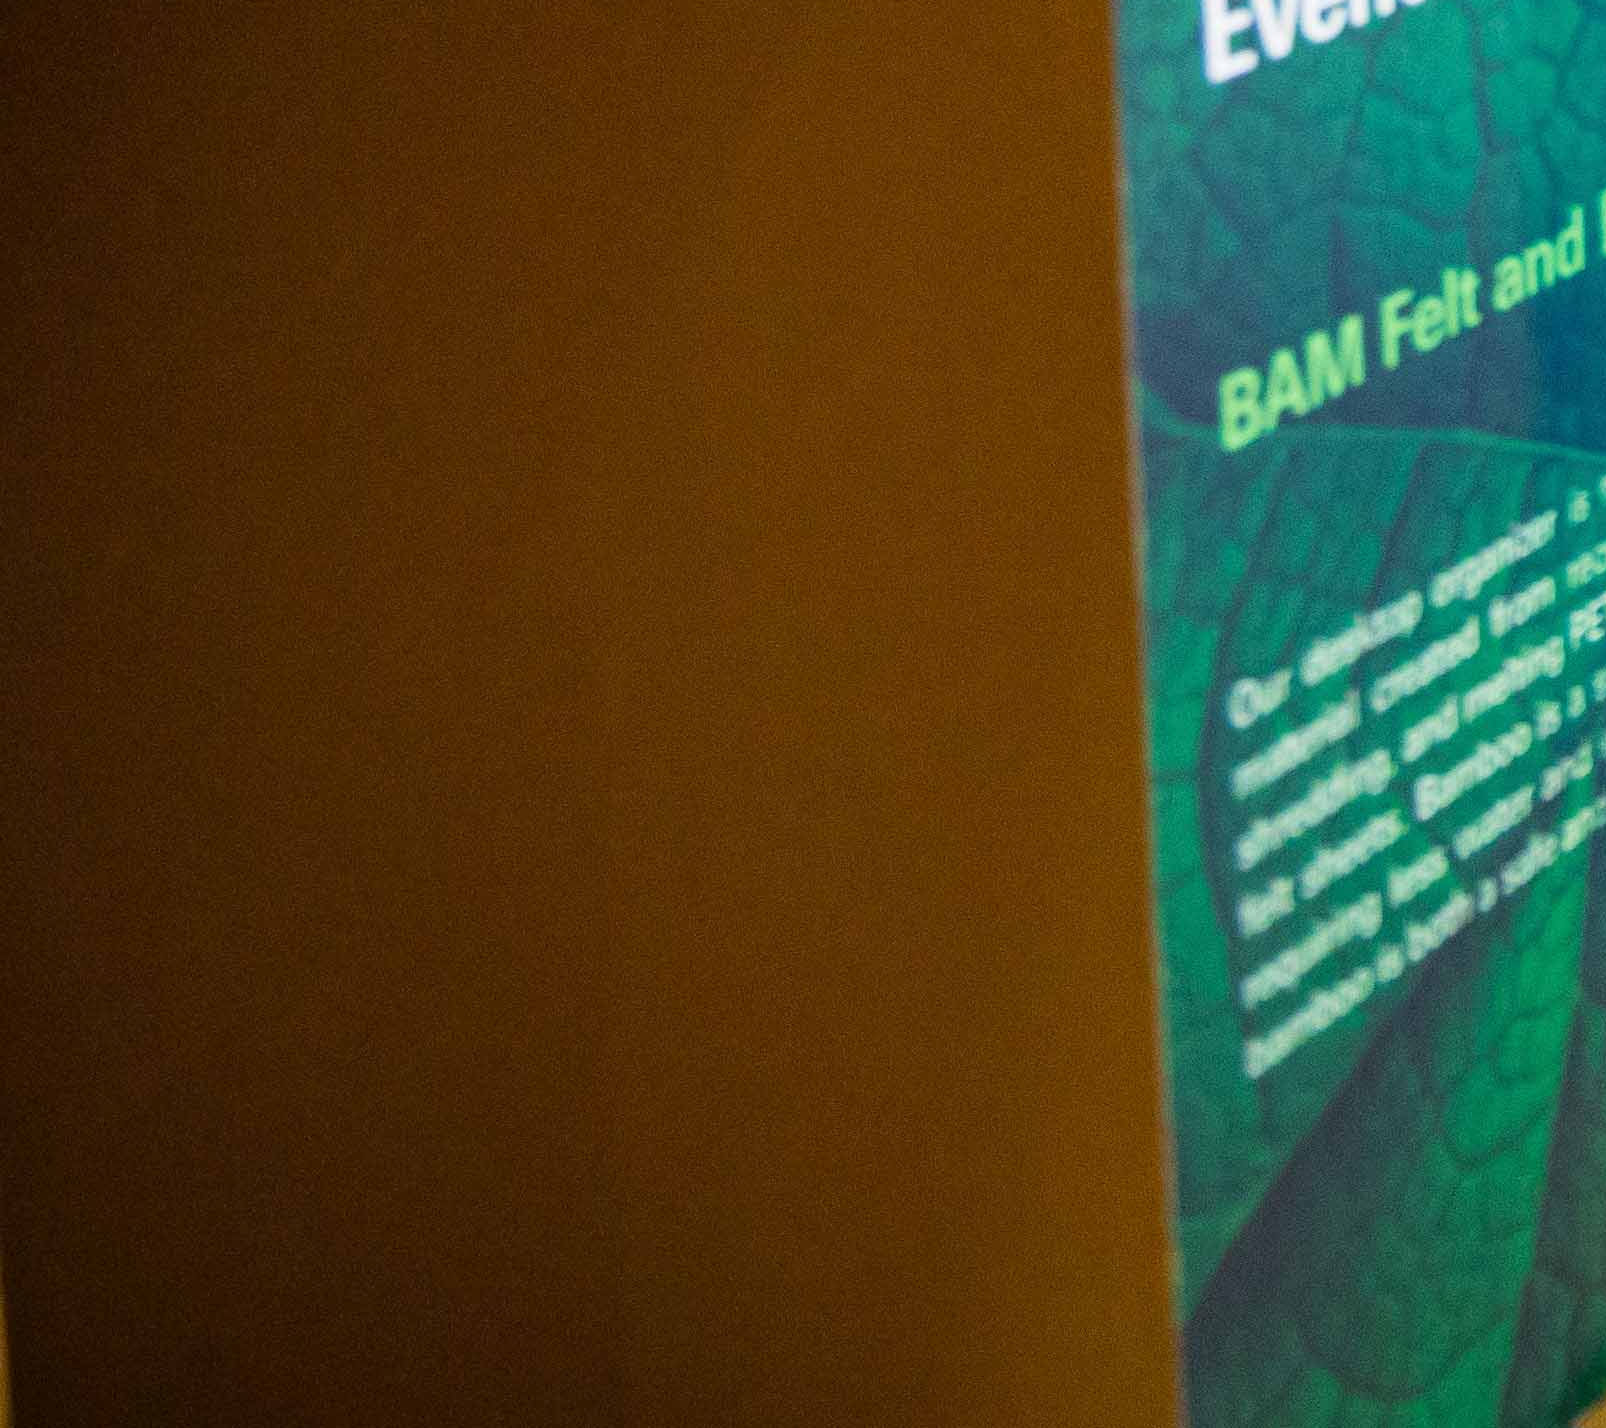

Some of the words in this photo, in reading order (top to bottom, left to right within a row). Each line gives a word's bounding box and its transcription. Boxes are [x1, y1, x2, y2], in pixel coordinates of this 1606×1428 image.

[1220, 314, 1365, 452] BAM
[1379, 268, 1481, 370] Felt
[1493, 204, 1587, 312] and
